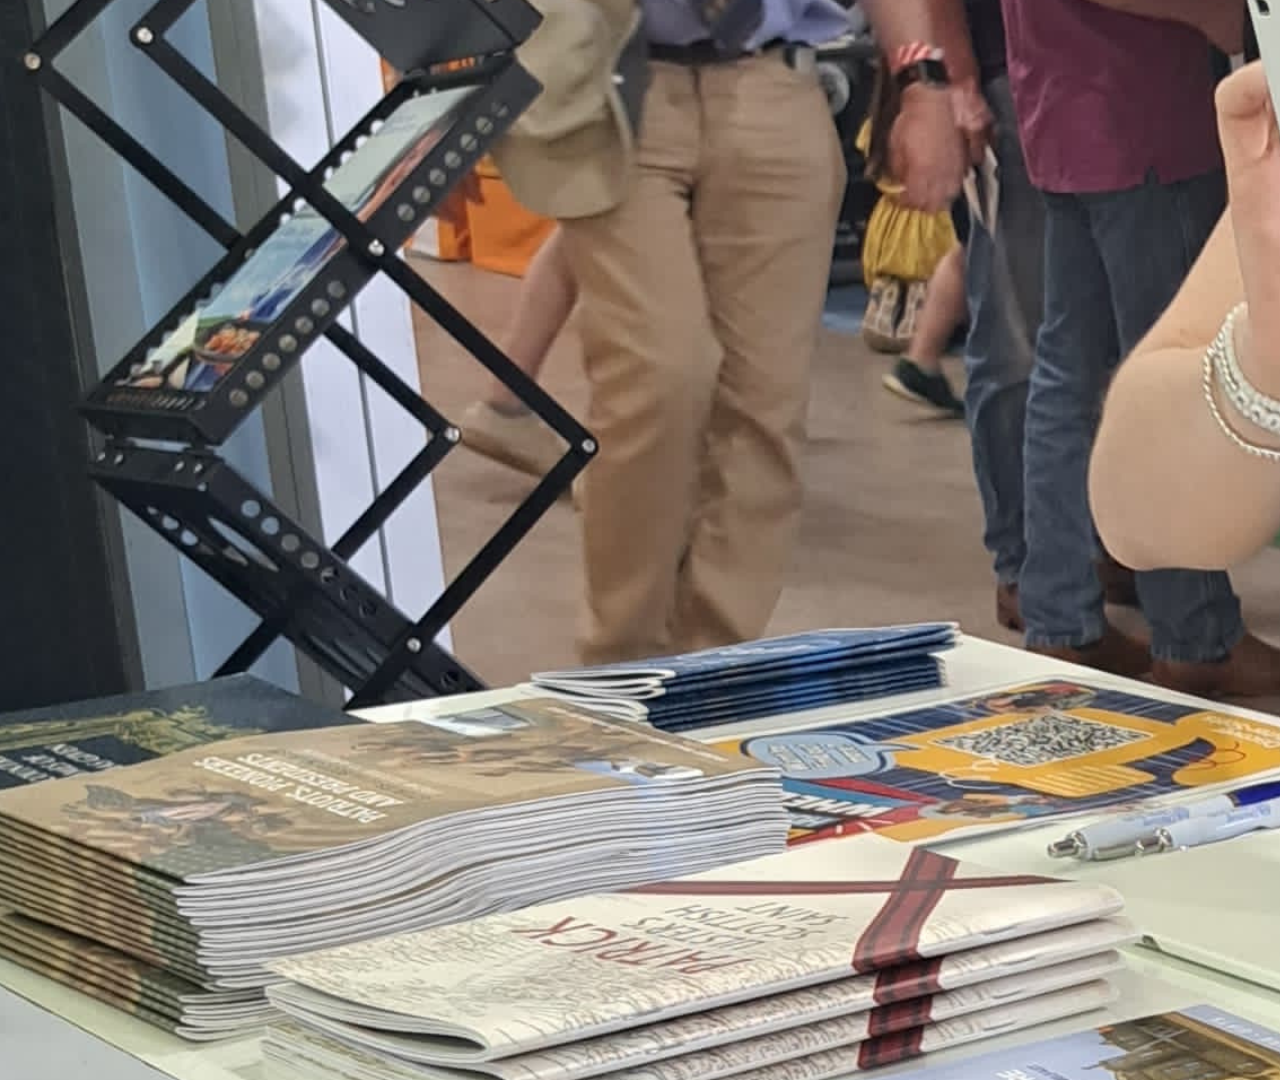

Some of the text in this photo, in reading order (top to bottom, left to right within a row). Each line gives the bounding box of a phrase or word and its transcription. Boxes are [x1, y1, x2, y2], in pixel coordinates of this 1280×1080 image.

[193, 756, 294, 793] PIONEERS
[236, 752, 360, 794] PRESIDENTS
[348, 790, 405, 808] AND
[663, 904, 827, 941] SCOTTISH
[735, 901, 848, 927] SAINT
[510, 916, 756, 976] PATRICK
